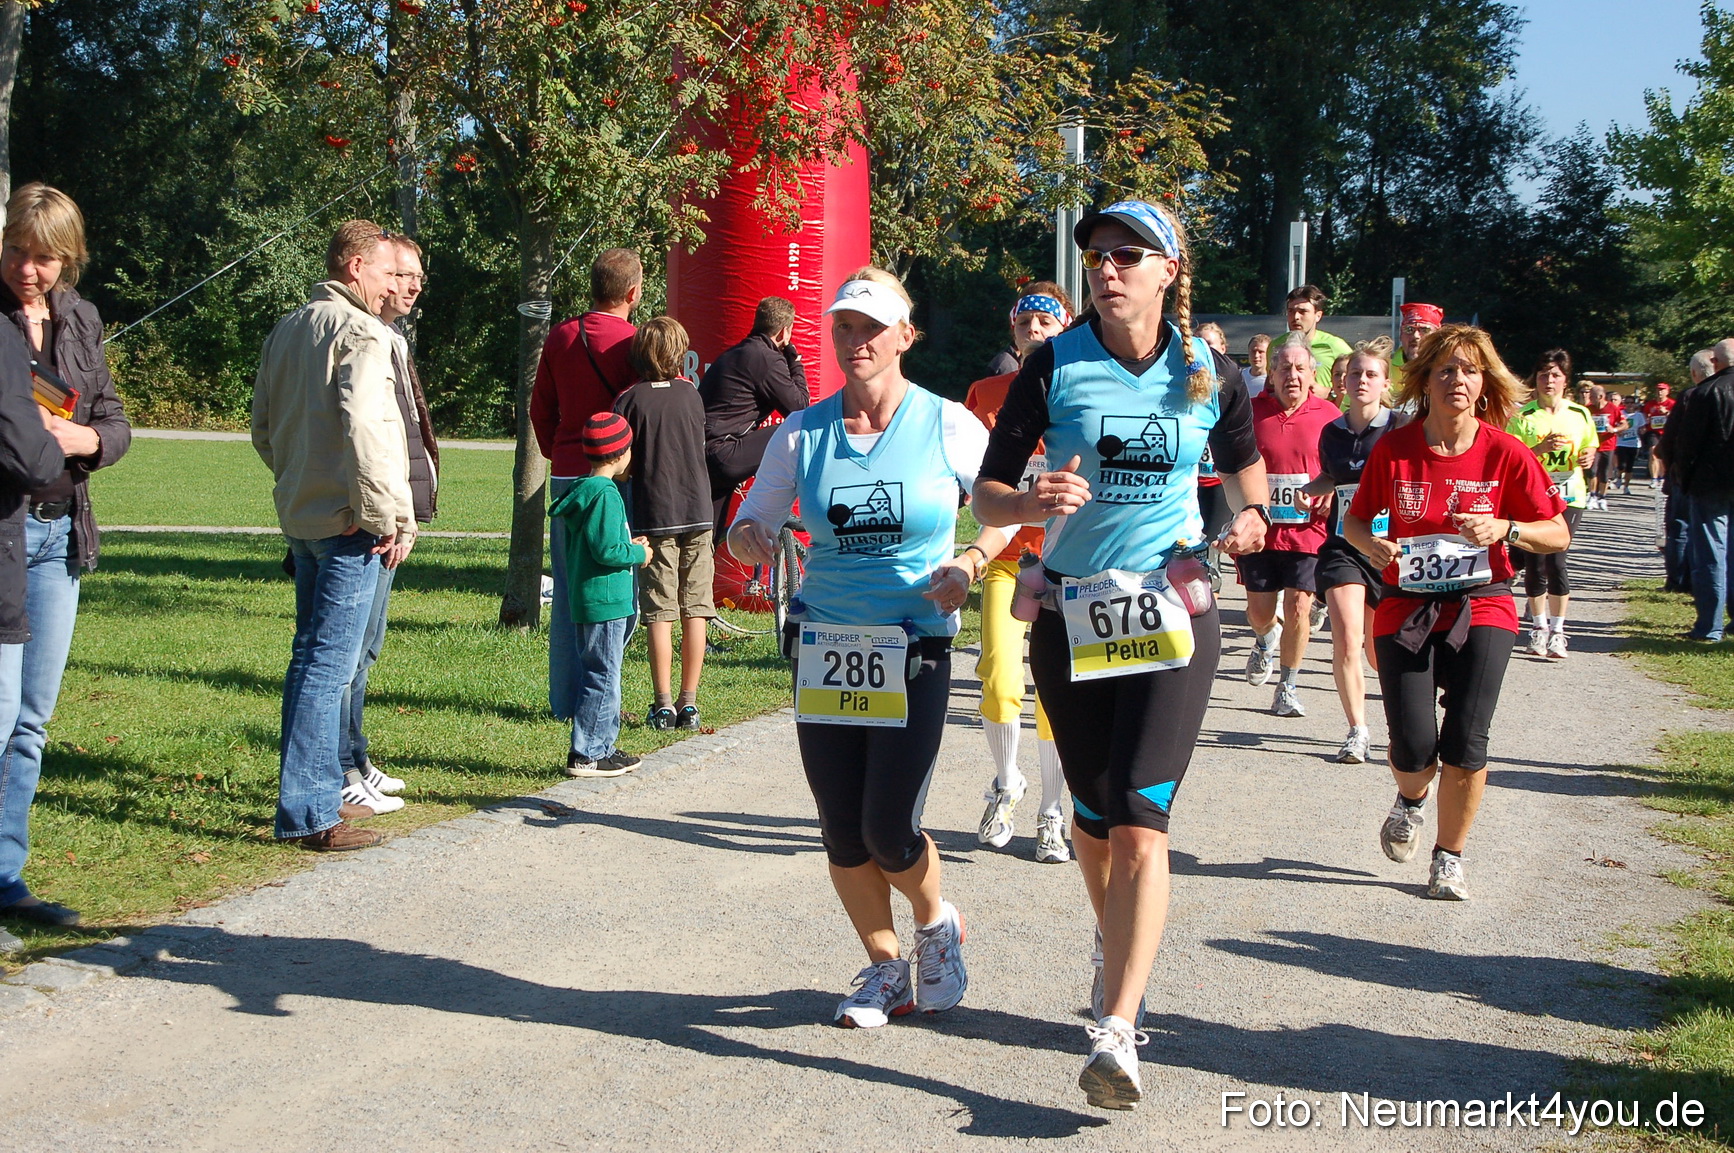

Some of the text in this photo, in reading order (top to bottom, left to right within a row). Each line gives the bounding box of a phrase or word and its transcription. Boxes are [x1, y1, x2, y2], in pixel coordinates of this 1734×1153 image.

[788, 242, 800, 291] Seit 1929
[1546, 450, 1567, 466] M
[1098, 470, 1169, 488] HIRSCH
[1445, 478, 1454, 486] 11.
[1398, 493, 1425, 501] WIEDER
[1399, 486, 1425, 495] IMMER
[1399, 500, 1422, 510] NEU
[1399, 509, 1421, 517] MARKT
[837, 534, 902, 551] HIRSCH
[1411, 541, 1444, 551] PFLEIDER
[1408, 553, 1478, 582] 3327
[1088, 592, 1162, 639] 678
[817, 631, 861, 643] PFLEIDERER
[1105, 639, 1159, 662] Petra
[822, 650, 885, 689] 286
[839, 691, 869, 712] Pia
